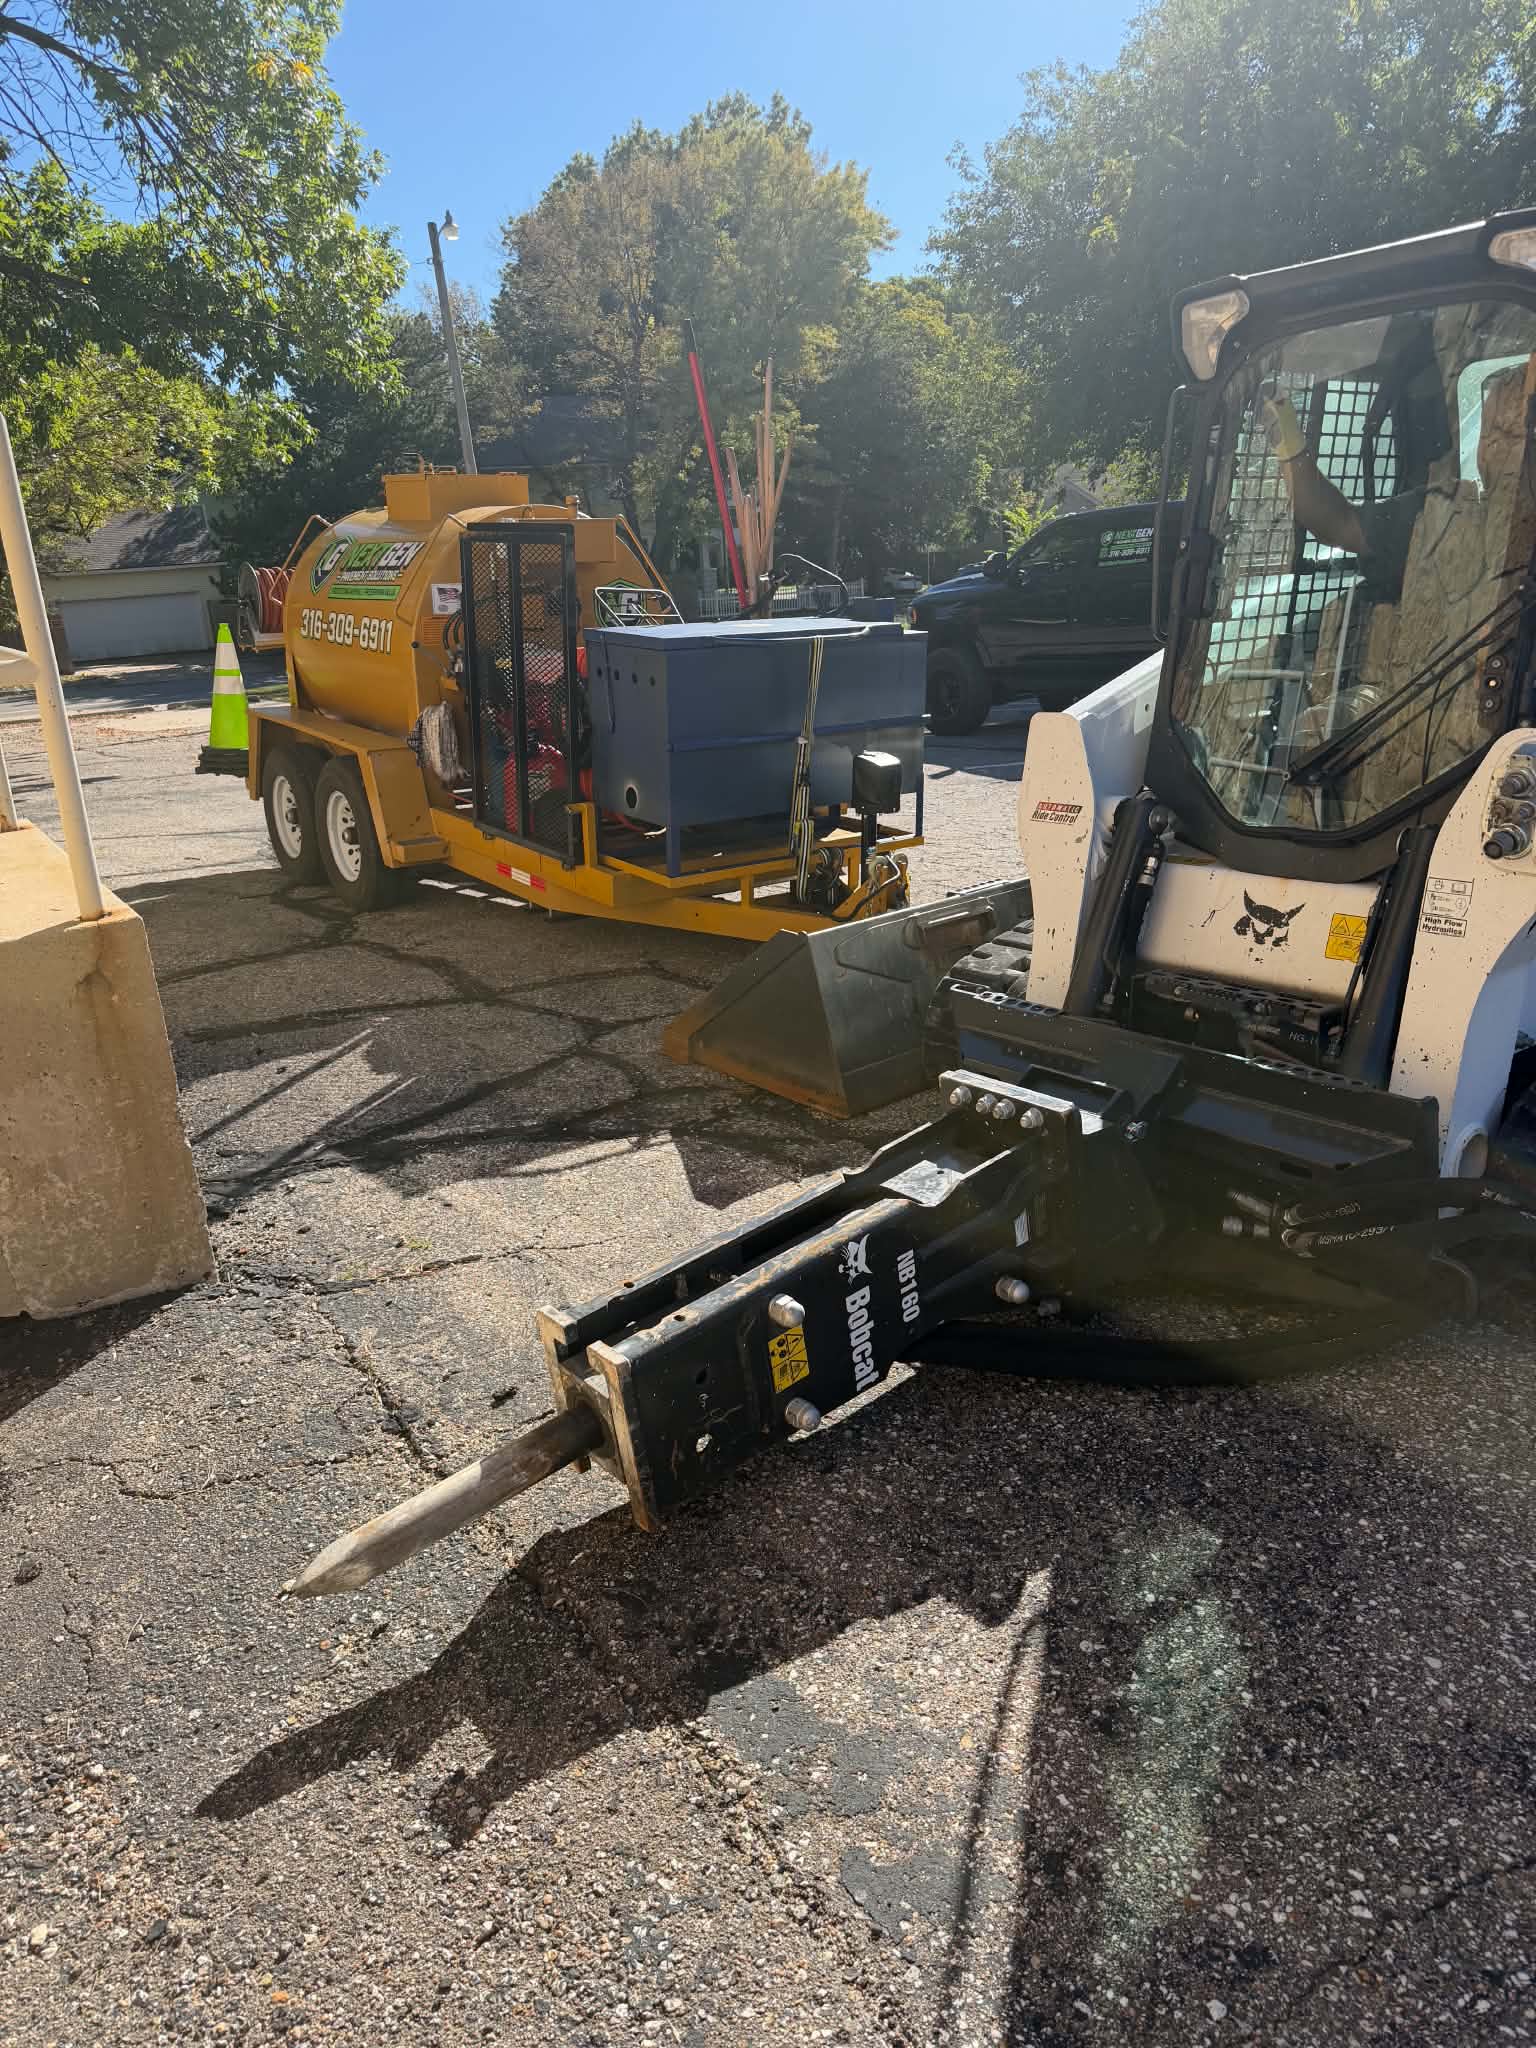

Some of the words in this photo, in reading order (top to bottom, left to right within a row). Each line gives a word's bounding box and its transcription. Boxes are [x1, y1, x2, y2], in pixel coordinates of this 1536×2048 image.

[343, 541, 426, 569] NEXTGEN
[300, 608, 393, 654] 316-309-6911
[1032, 810, 1048, 820] Ride
[1048, 812, 1079, 824] Control
[1422, 924, 1463, 935] Hydraulics
[1425, 916, 1442, 925] High
[1444, 919, 1463, 928] Flow
[896, 1249, 920, 1323] NB160
[846, 1286, 880, 1392] Bobcat
